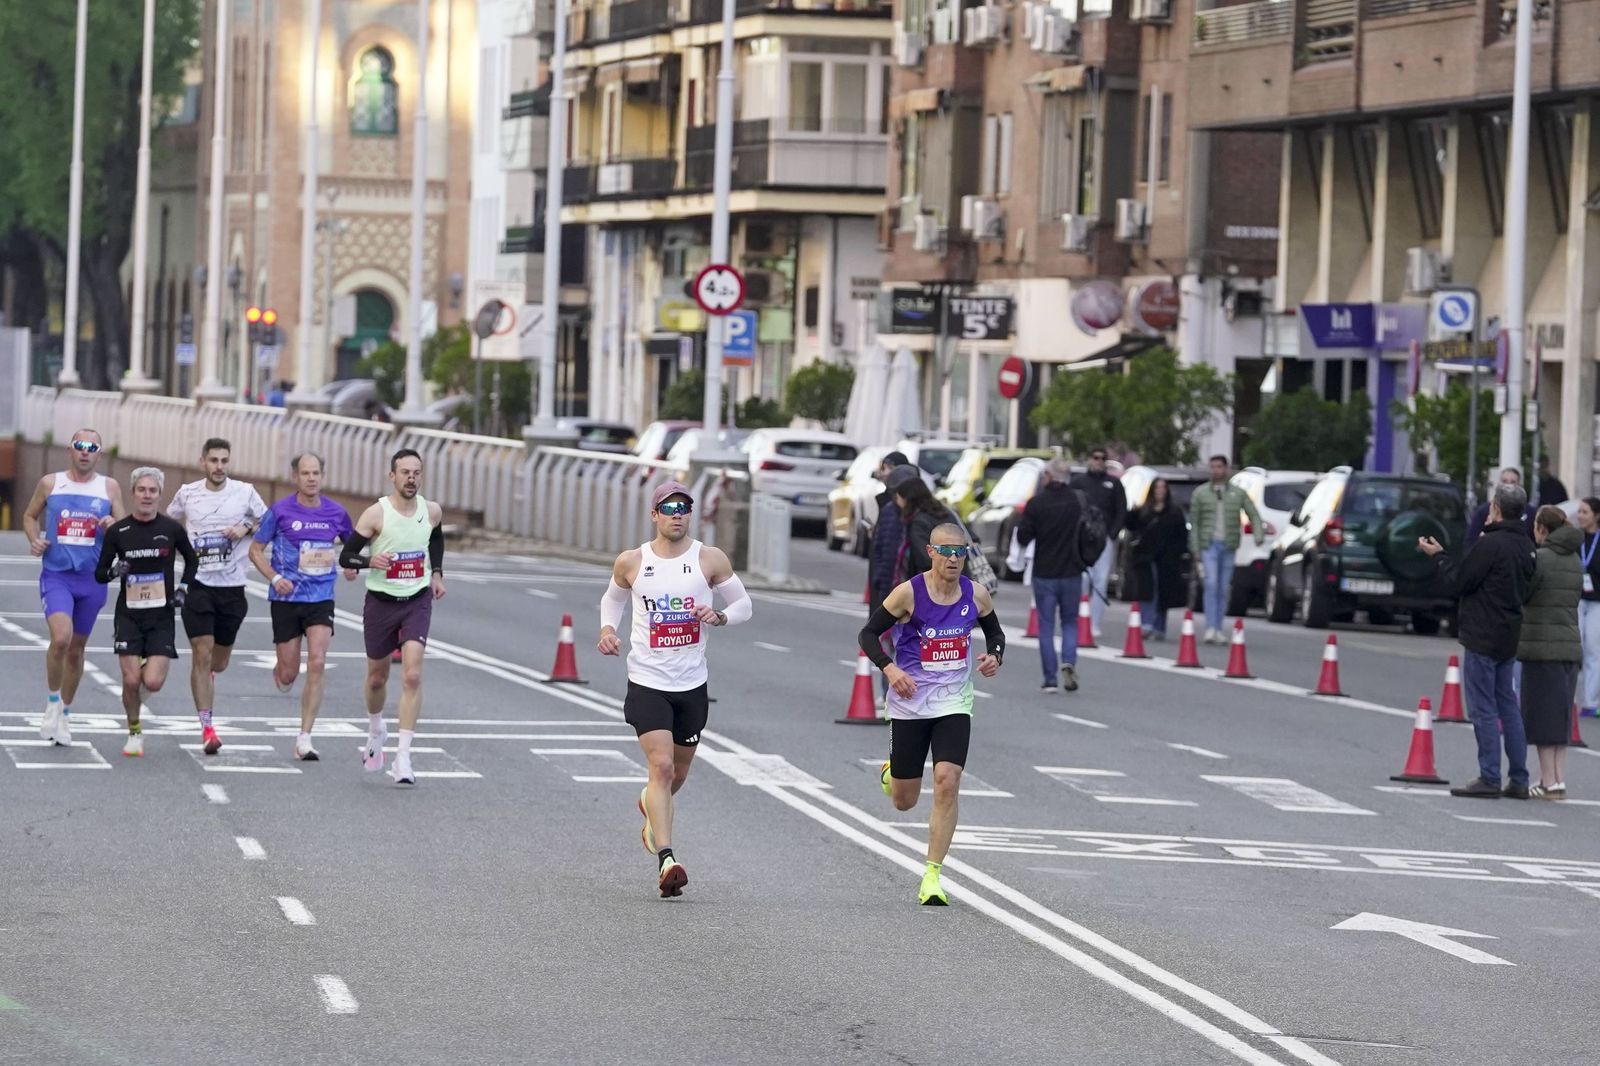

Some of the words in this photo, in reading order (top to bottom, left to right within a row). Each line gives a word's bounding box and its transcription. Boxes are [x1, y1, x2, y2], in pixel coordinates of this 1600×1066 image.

[949, 298, 1007, 315] TINTE
[724, 316, 747, 346] P
[67, 528, 87, 537] GUTY
[199, 555, 219, 564] ERGIO
[400, 552, 423, 560] ZURICH
[398, 570, 416, 578] IVAN
[642, 594, 695, 611] indea
[938, 627, 964, 636] ZURICH
[658, 634, 692, 647] POYATO
[939, 641, 954, 649] 1215
[932, 650, 960, 661] DAVID
